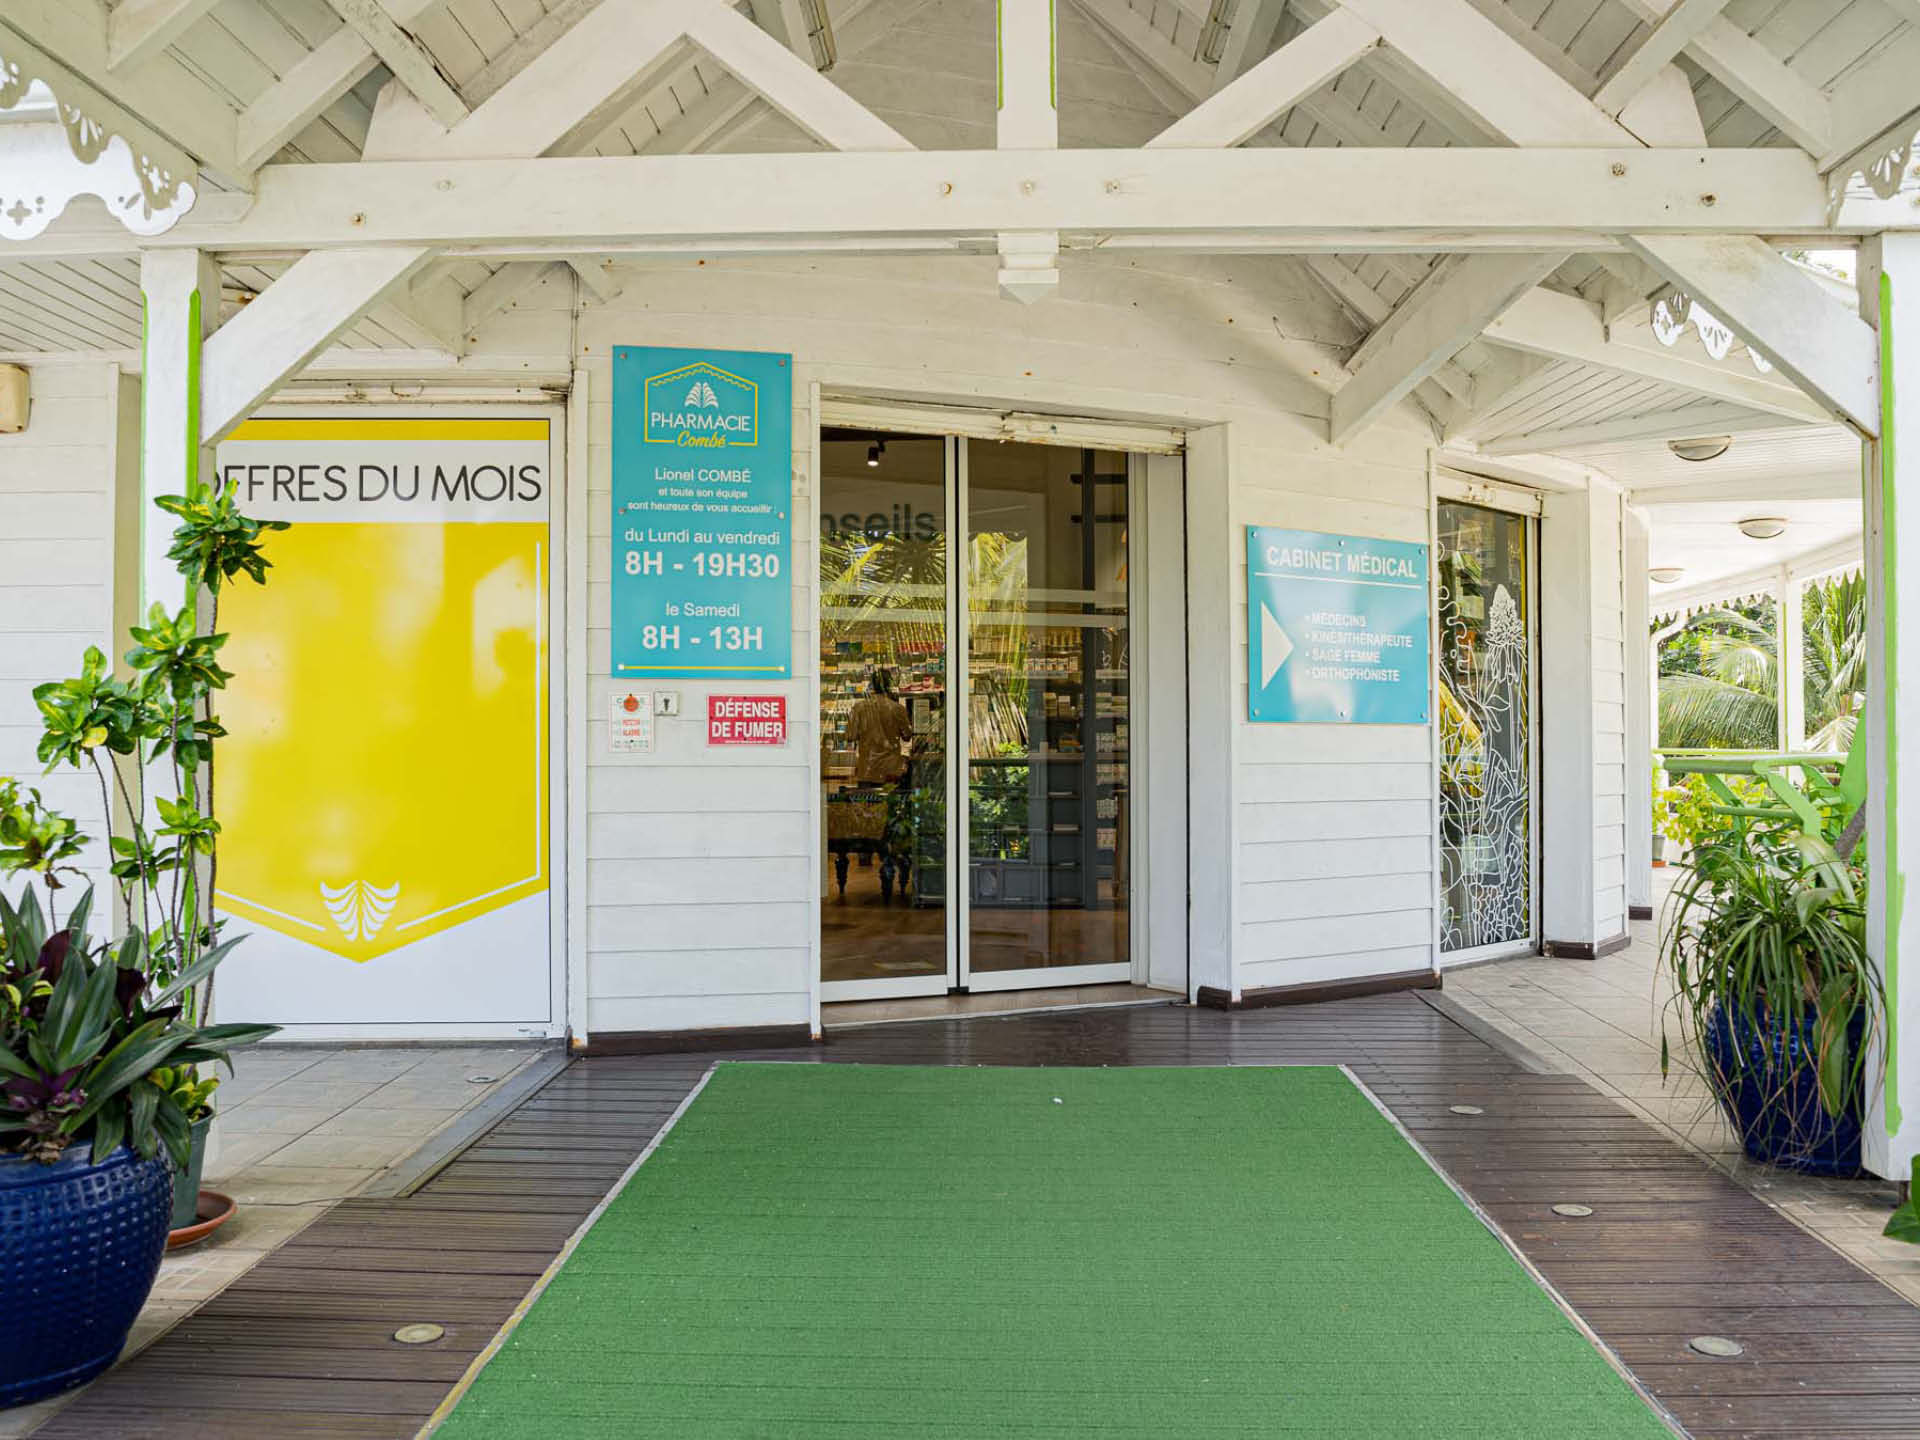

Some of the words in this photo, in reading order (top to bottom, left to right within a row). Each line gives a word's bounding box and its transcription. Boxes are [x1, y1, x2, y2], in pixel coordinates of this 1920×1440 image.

[651, 412, 752, 431] PHARMACIE
[677, 430, 726, 448] Combé
[215, 465, 347, 502] FFRES
[359, 465, 419, 502] DU
[432, 465, 543, 502] MOIS
[655, 467, 694, 482] Lionel
[698, 468, 752, 483] COMBÉ
[670, 488, 694, 497] toute
[696, 489, 713, 497] son
[716, 488, 748, 500] équipe
[628, 501, 649, 510] sont
[651, 502, 689, 511] heureux
[691, 502, 704, 511] de
[706, 504, 729, 512] vous
[624, 528, 643, 542] du
[648, 528, 689, 543] Lundi
[694, 532, 712, 544] au
[716, 531, 780, 545] vendredi
[625, 551, 663, 575] 8H
[692, 552, 780, 578] 19H30
[1267, 546, 1344, 572] CABINET
[1347, 551, 1418, 577] MÉDICAL
[665, 602, 679, 616] le
[684, 602, 741, 617] Samedi
[642, 626, 680, 650] 8H
[709, 626, 763, 650] 13H
[1311, 648, 1343, 662] SAGE
[715, 698, 780, 718] DÉFENSE
[711, 721, 731, 737] DE
[735, 722, 783, 738] FUMER
